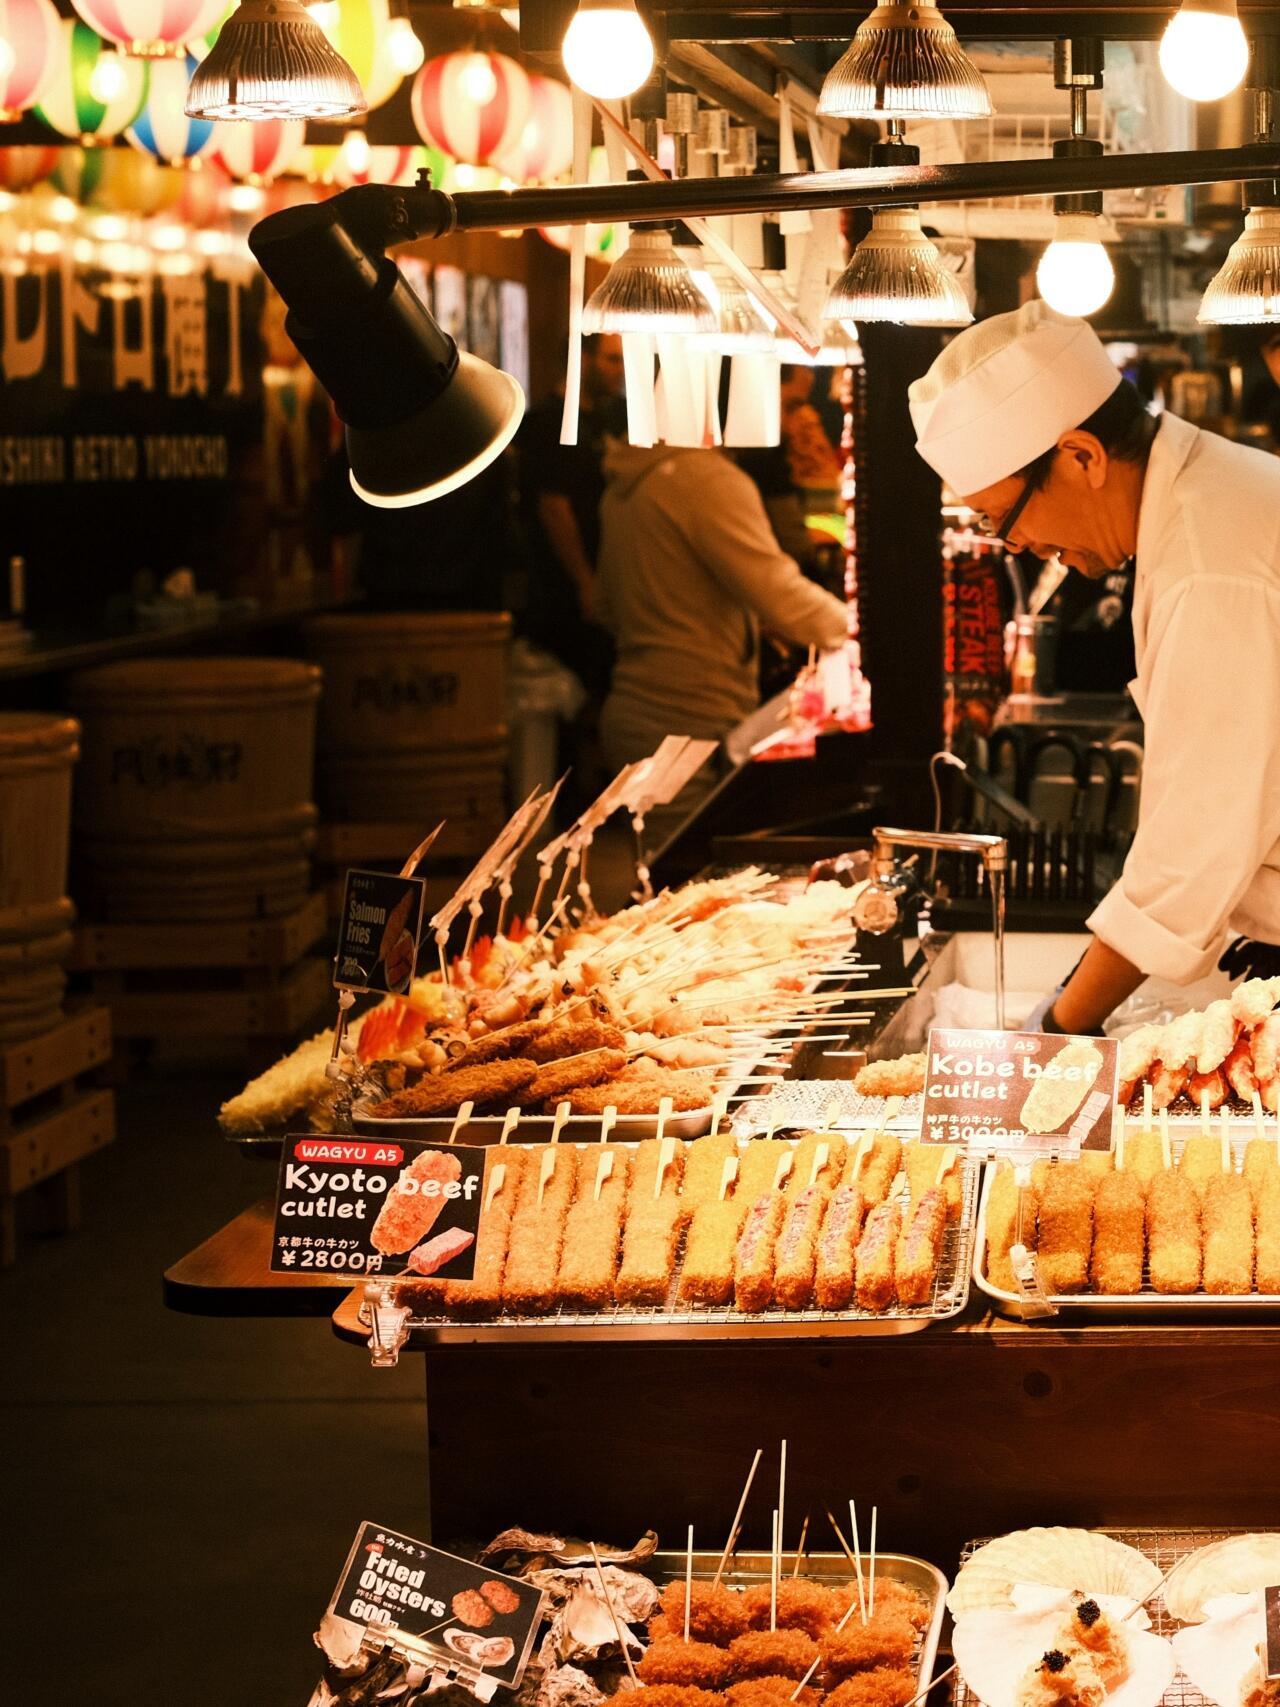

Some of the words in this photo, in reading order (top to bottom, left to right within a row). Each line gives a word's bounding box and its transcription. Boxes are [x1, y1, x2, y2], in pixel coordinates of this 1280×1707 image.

[73, 434, 137, 481] RETRO
[959, 583, 987, 674] STEAK
[349, 900, 386, 925] Salmon
[346, 921, 371, 945] Fries
[945, 1038, 1007, 1050] WAGYU
[1014, 1041, 1036, 1052] A5
[931, 1053, 1016, 1078] Kobe
[1022, 1056, 1099, 1083] beef
[928, 1080, 1009, 1100] cutlet
[926, 1114, 1004, 1126] 神戸牛の牛カツ
[302, 1144, 367, 1160] WAGYU
[373, 1148, 397, 1162] A5
[285, 1163, 388, 1194] Kyoto
[399, 1168, 480, 1200] beef
[280, 1195, 367, 1220] cutlet
[277, 1235, 360, 1249] 京都牛の牛カツ
[281, 1249, 383, 1272] ¥2800円
[365, 1551, 426, 1589] Fried
[359, 1569, 447, 1618] Oysters
